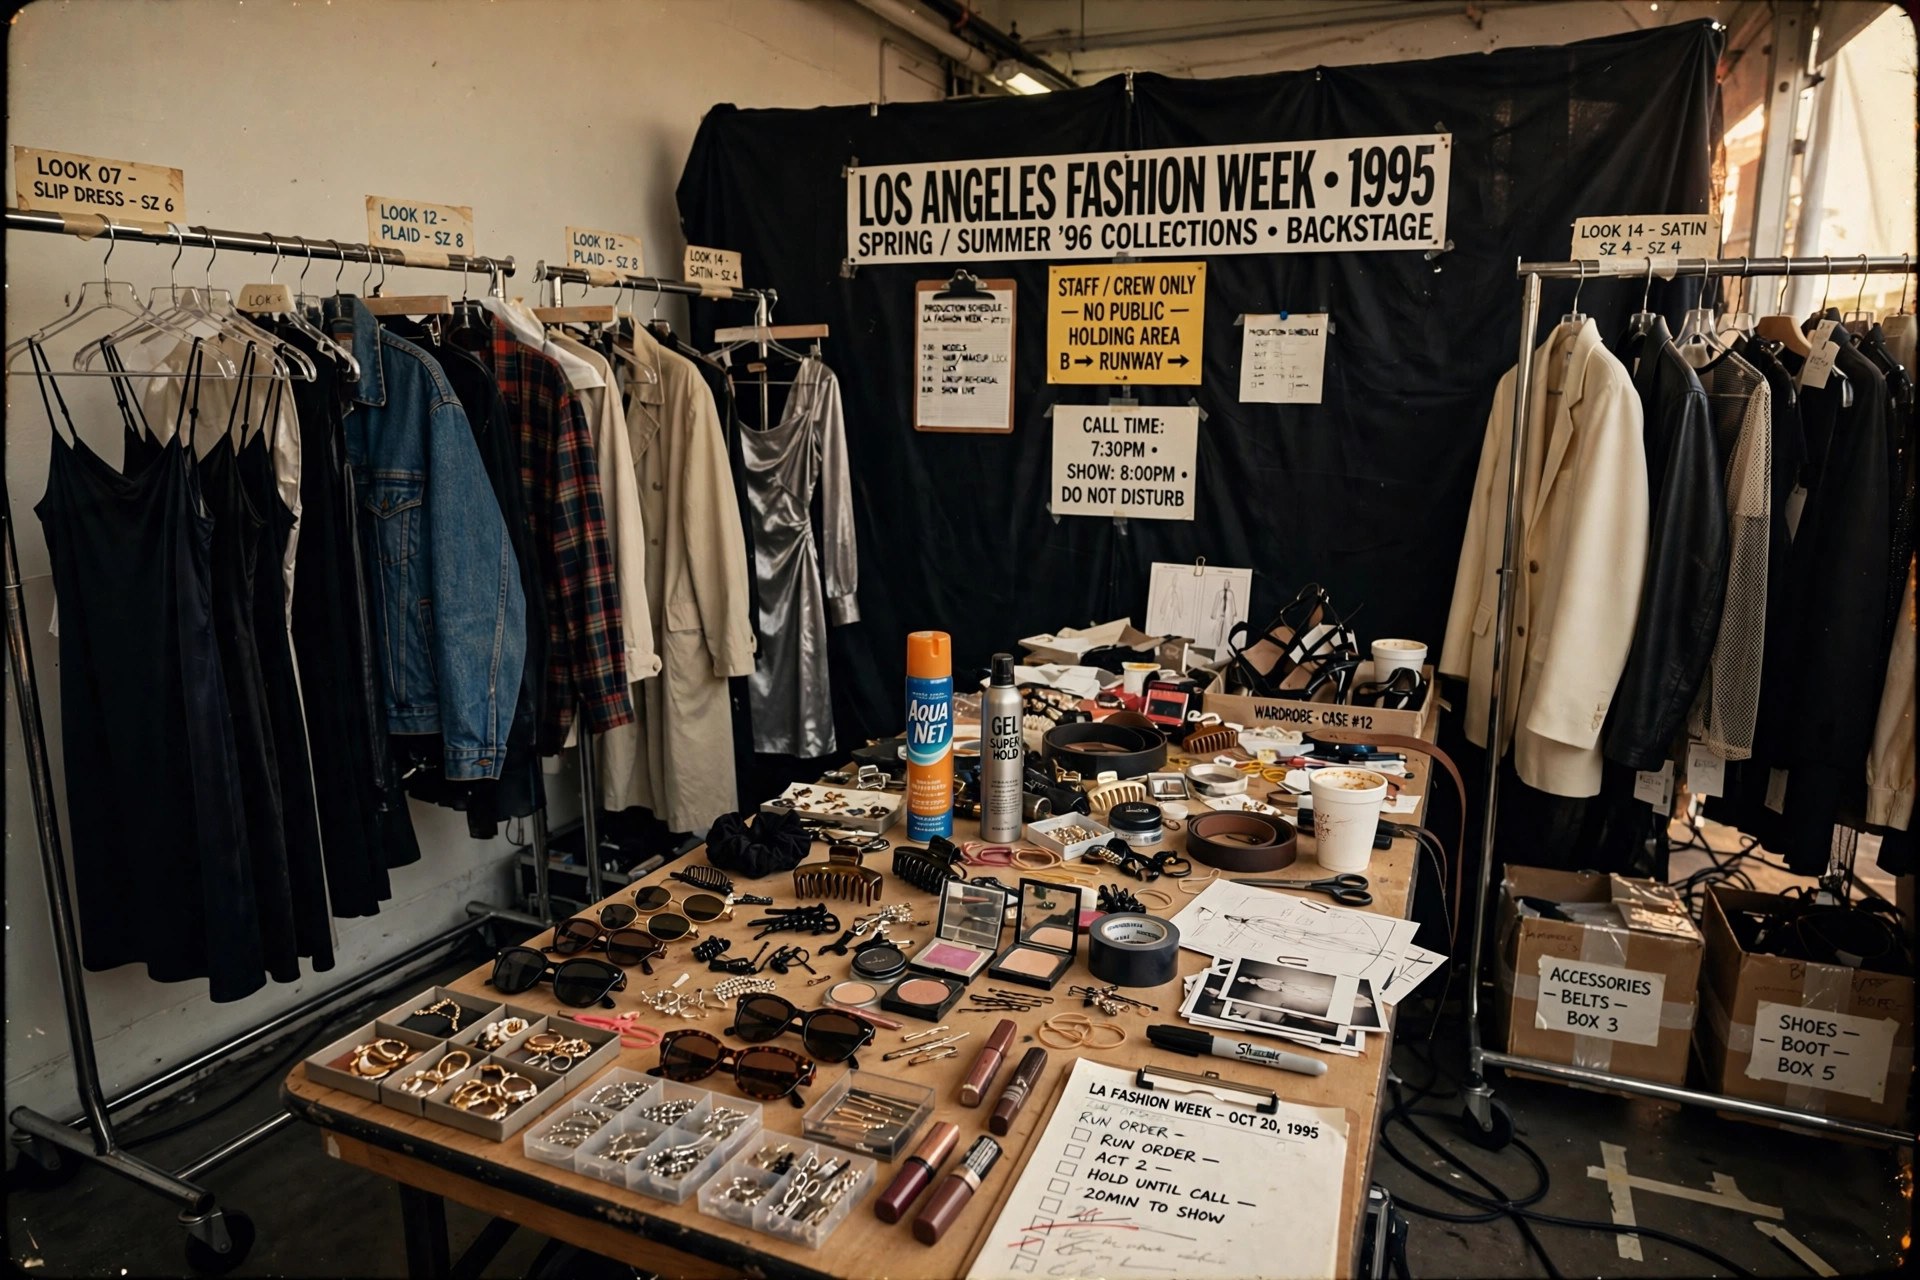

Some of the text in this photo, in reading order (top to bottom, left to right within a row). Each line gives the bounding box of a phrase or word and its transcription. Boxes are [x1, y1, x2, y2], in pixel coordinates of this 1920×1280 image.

[37, 157, 121, 185] LOOK 07
[859, 144, 1436, 226] LOS ANGELES FASHION WEEK 1995
[34, 181, 174, 212] SLIP DRESS SZ 6
[381, 204, 437, 225] LOOK 12
[382, 224, 464, 248] PLAID SZ 8
[573, 232, 616, 250] LOOK 12
[858, 230, 933, 257] SPRING
[957, 226, 1051, 254] SUMMER
[1101, 217, 1258, 250] COLLECTIONS
[1286, 212, 1434, 244] BACKSTAGE
[1581, 222, 1707, 239] LOOK 14 SATIN
[690, 249, 723, 266] LOOK 14
[1600, 240, 1682, 256] SZ 4 SZ 4
[574, 250, 638, 270] PLAID SZ 8
[690, 265, 713, 278] SATIN
[721, 269, 731, 281] SZ
[1058, 277, 1099, 296] STAFF
[1114, 276, 1155, 295] CREW
[1160, 275, 1196, 295] ONLY
[1084, 301, 1164, 321] NO PUBLIC
[1069, 327, 1180, 345] HOLDING AREA
[1061, 352, 1163, 370] B RUNWAY
[1083, 416, 1165, 434] CALL TIME:
[1091, 441, 1145, 457] 7:30PM
[1067, 463, 1175, 482] SHOW: 8:00PM
[1062, 486, 1184, 507] DO NOT DISTURB
[908, 699, 948, 722] AQUA
[1254, 705, 1373, 729] WARDROBE CASE #12
[913, 721, 948, 744] NET
[991, 716, 1019, 736] GEL
[990, 736, 1020, 749] SUPER
[993, 748, 1019, 760] HOLD
[1550, 967, 1652, 996] ACCESSORIES
[1561, 989, 1609, 1009] BELTS
[1567, 1011, 1619, 1032] BOX 3
[1779, 1015, 1838, 1038] SHOES
[1781, 1036, 1830, 1056] BOOT
[1778, 1057, 1837, 1081] BOX 5
[1089, 1082, 1106, 1097] LA
[1110, 1088, 1170, 1110] FASHION
[1174, 1100, 1213, 1119] WEEK
[1228, 1111, 1257, 1127] OCT
[1260, 1117, 1281, 1134] 20,
[1287, 1123, 1319, 1139] 1995
[1079, 1111, 1112, 1127] RUN
[1119, 1120, 1168, 1138] ORDER
[1100, 1134, 1196, 1163] RUN ORDER
[1095, 1152, 1148, 1171] ACT 2
[1087, 1168, 1230, 1205] HOLD UNTIL CALL
[1083, 1187, 1226, 1224] 20MIN TO SHOW
